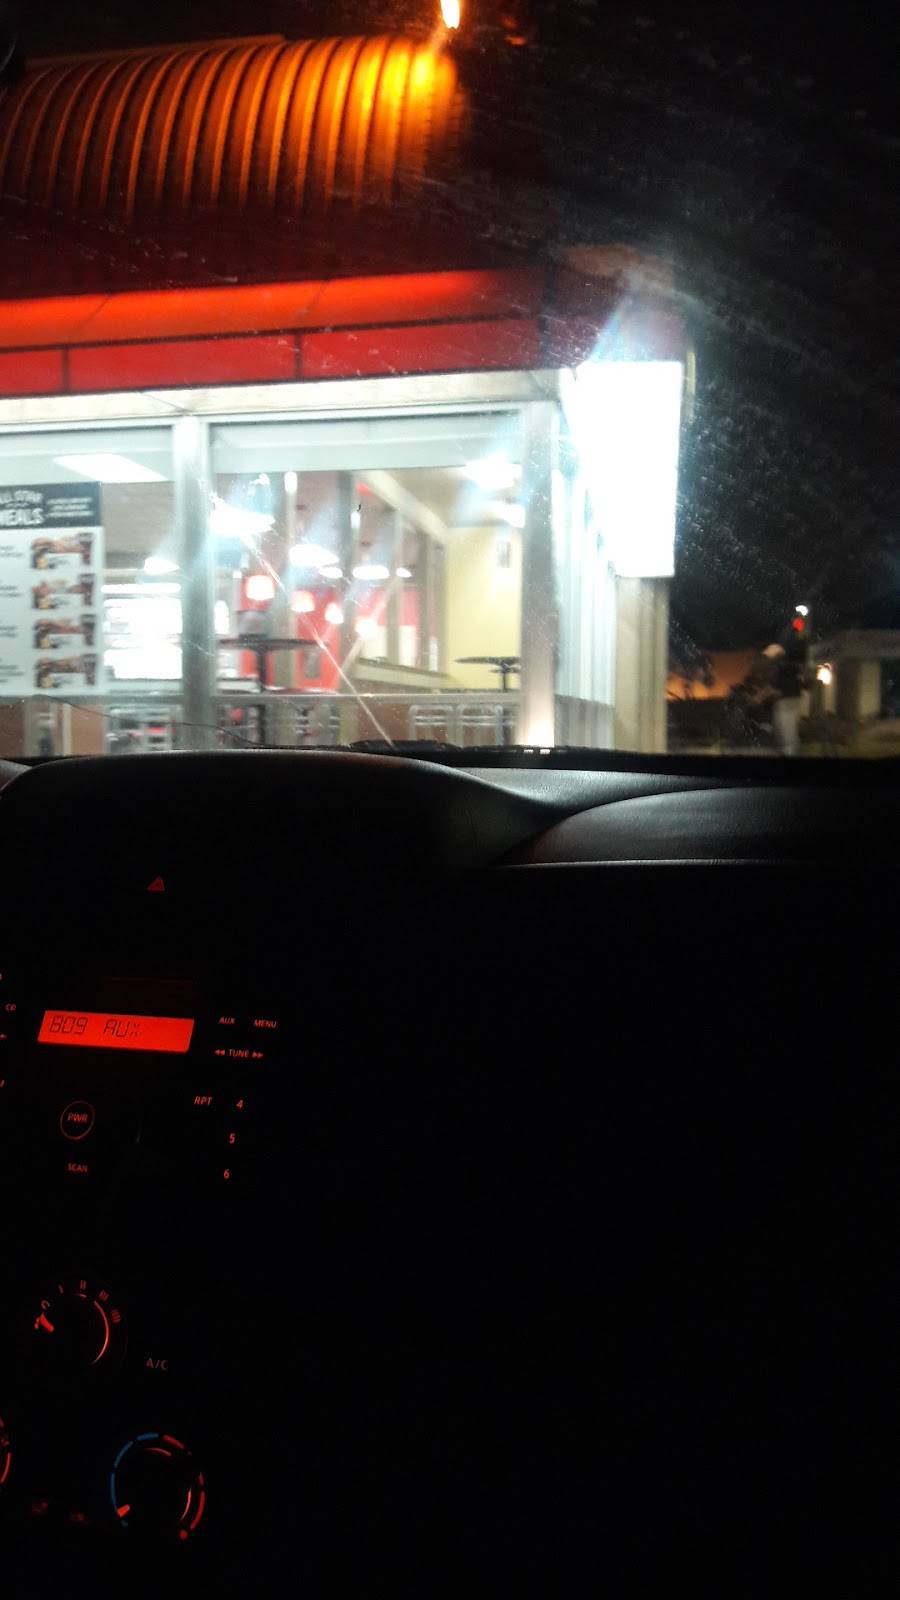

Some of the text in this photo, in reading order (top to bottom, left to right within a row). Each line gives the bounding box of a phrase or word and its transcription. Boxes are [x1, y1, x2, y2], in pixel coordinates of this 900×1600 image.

[218, 1016, 236, 1025] AUX
[253, 1018, 278, 1029] MENU
[228, 1049, 250, 1059] TUNE
[193, 1096, 213, 1106] RPT
[236, 1099, 245, 1109] 4
[67, 1113, 89, 1123] PWR
[228, 1133, 236, 1144] 5
[67, 1163, 89, 1173] SCAN
[222, 1169, 231, 1179] 6
[145, 1358, 169, 1371] A/C
